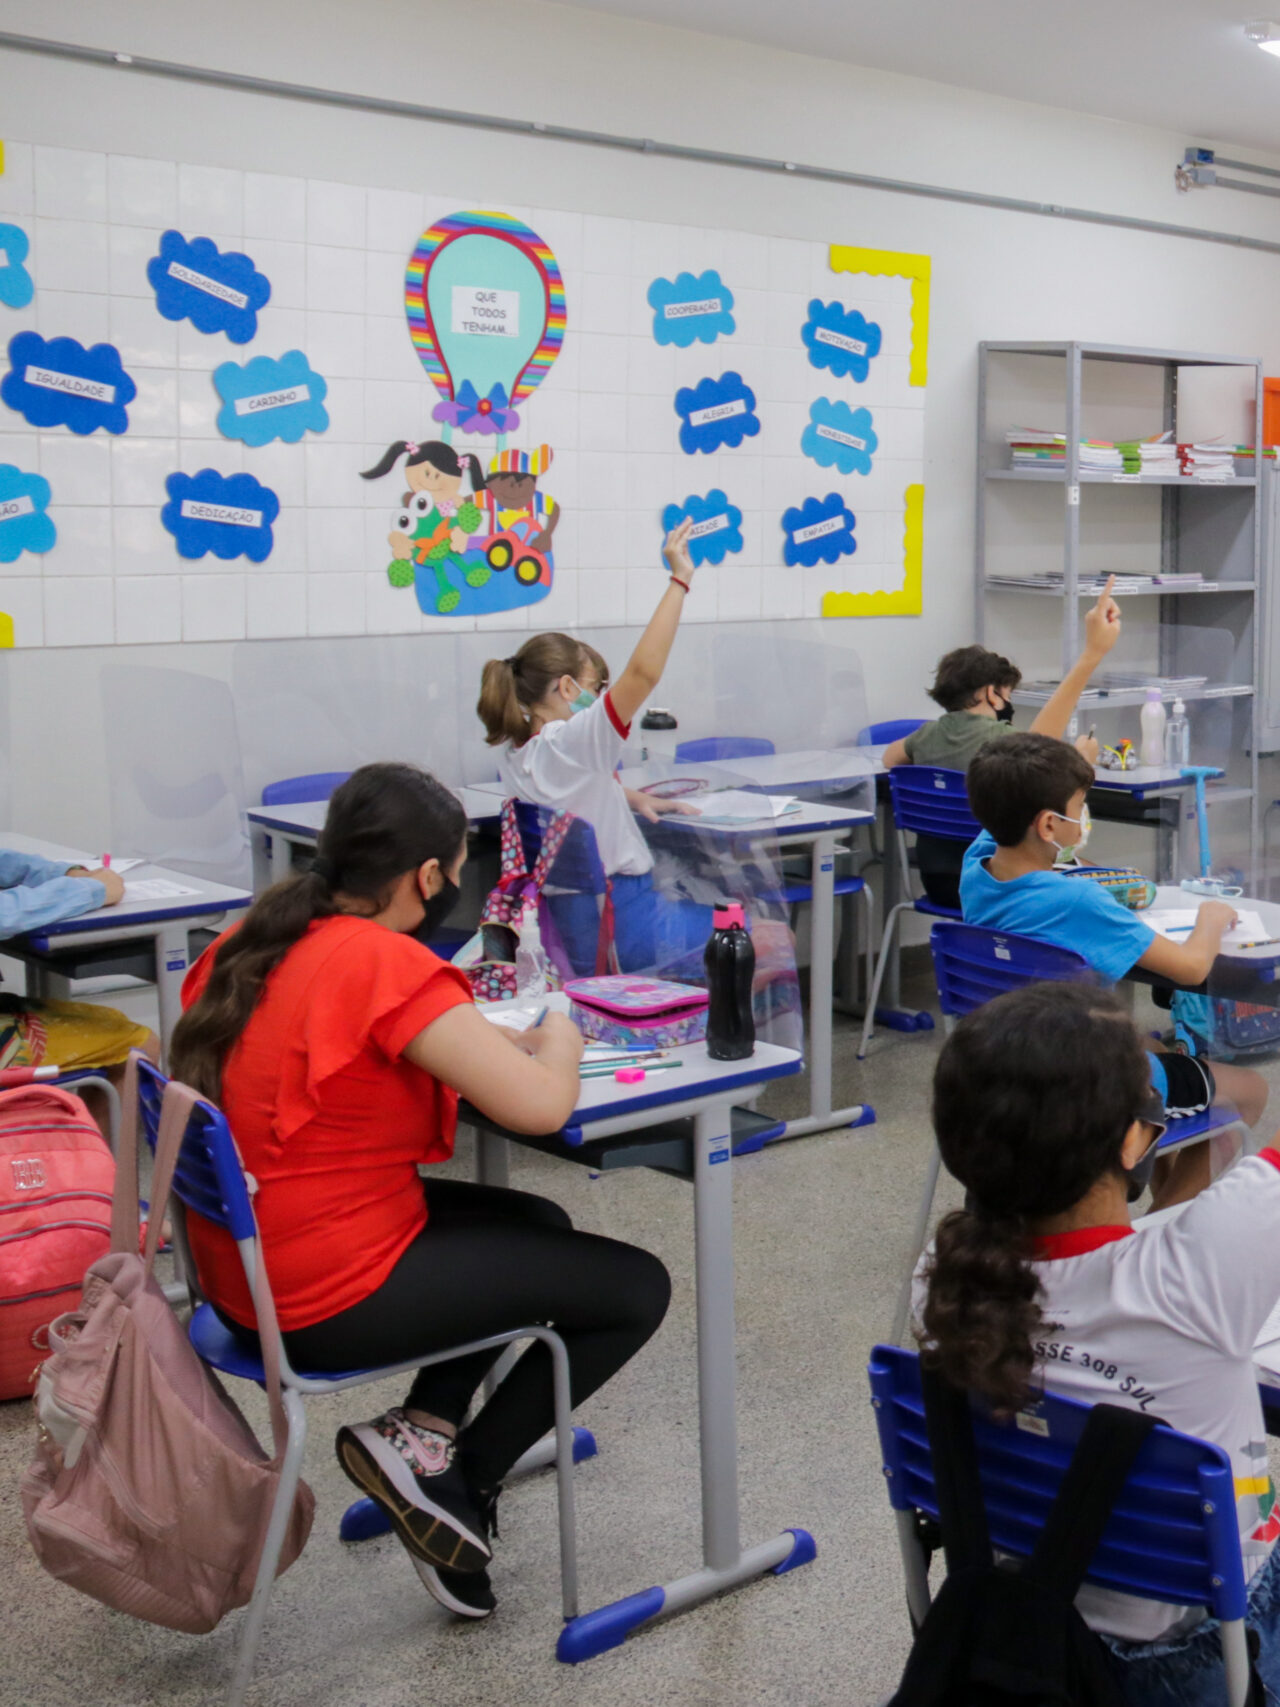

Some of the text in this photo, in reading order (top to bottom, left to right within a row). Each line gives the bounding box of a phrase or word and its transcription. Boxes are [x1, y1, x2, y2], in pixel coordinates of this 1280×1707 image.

[170, 265, 246, 306] SOLIDARIEDADE
[475, 291, 497, 303] QUE
[472, 306, 506, 319] TODOS
[35, 371, 105, 398] IGUALDADE
[248, 391, 297, 409] CARINHO
[702, 406, 735, 420] ALEGRIA
[0, 503, 19, 517] ÃO
[191, 505, 254, 523] DEDICAÇÃO
[802, 522, 835, 538] EMPATIA
[1034, 1341, 1156, 1411] SSE 308 SUL
